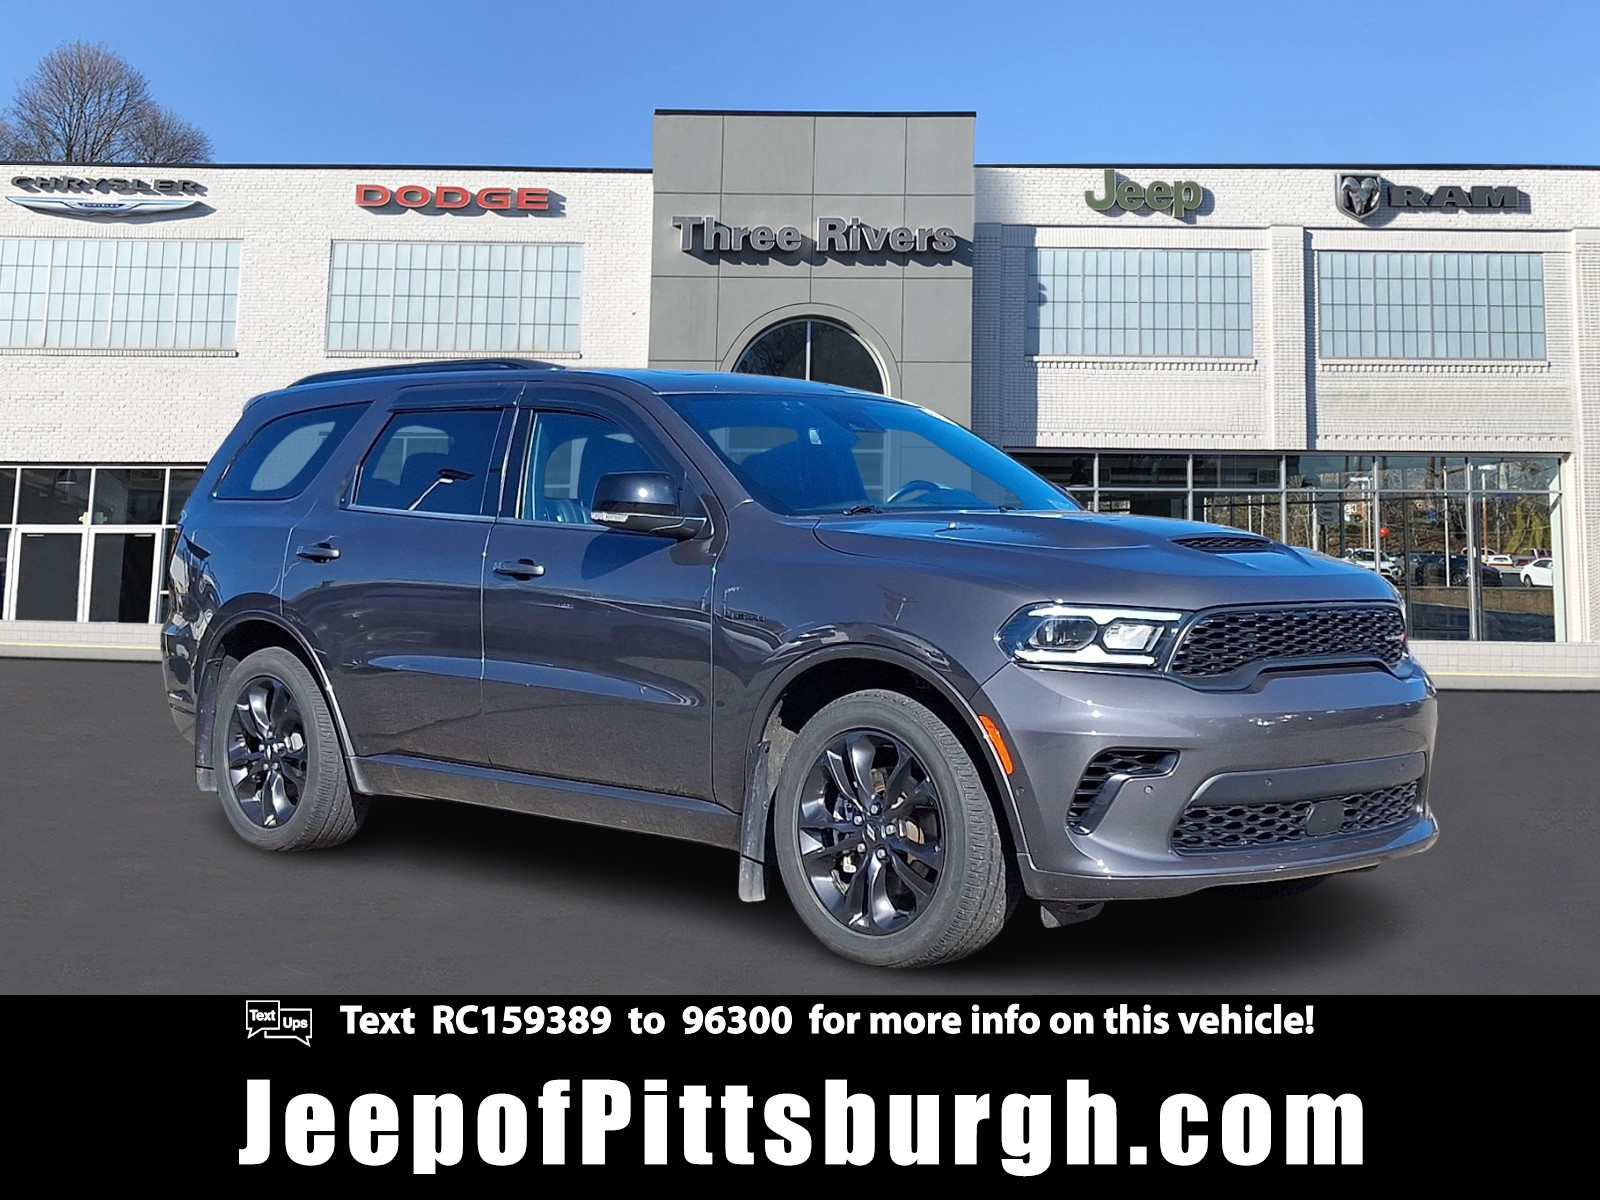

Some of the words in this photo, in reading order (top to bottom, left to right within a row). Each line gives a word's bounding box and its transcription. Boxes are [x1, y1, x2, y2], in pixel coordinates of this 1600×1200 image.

[10, 175, 197, 193] CHRYSLER
[355, 184, 550, 209] DODGE
[1084, 168, 1203, 218] Jeep
[1387, 185, 1519, 207] RAM
[671, 215, 802, 252] Three
[815, 215, 957, 253] Rivers
